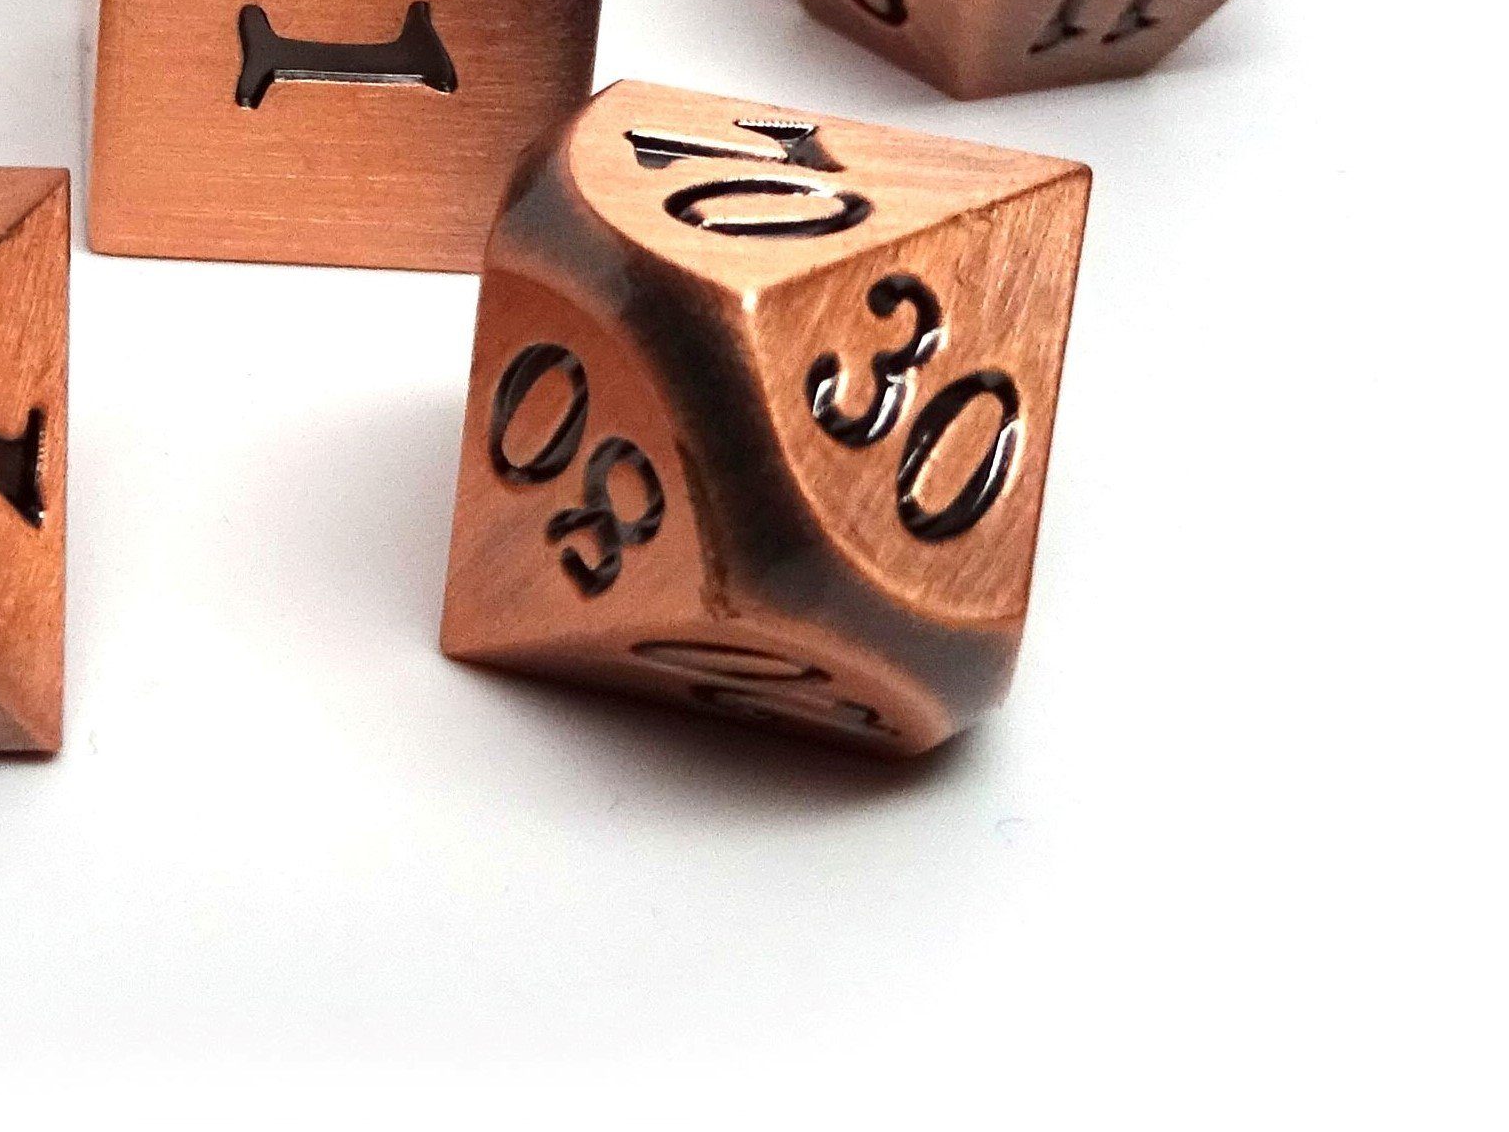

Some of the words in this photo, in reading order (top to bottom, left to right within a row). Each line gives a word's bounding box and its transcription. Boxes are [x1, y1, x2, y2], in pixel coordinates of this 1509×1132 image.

[234, 1, 458, 110] 1
[624, 119, 874, 237] 10
[491, 342, 666, 599] 80
[805, 273, 1022, 543] 30
